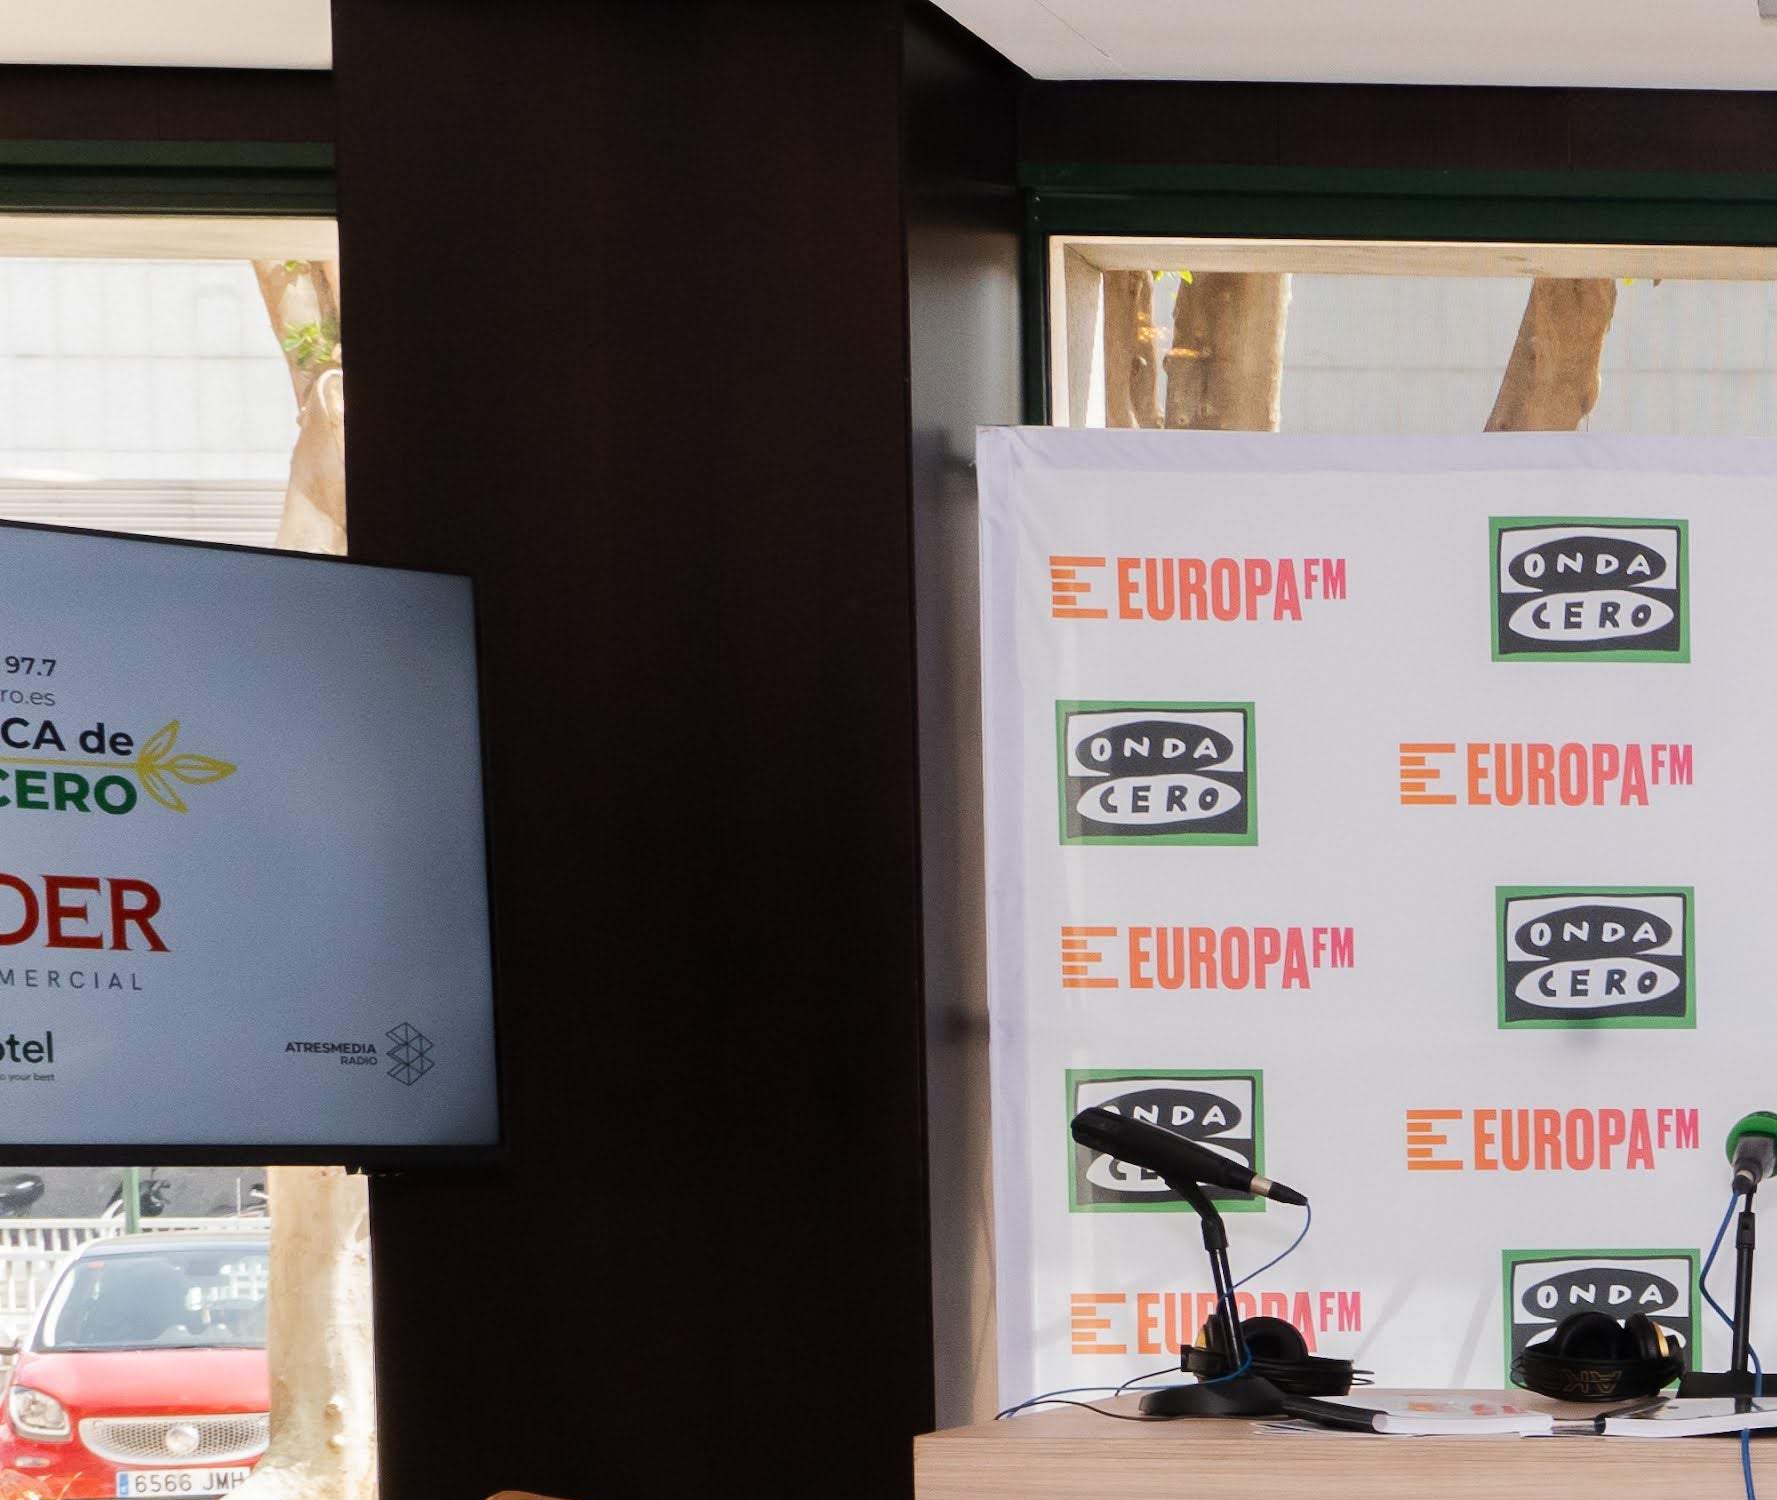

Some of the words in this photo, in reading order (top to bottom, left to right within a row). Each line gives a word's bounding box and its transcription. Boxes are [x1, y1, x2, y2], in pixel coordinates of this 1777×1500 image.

[1524, 553, 1650, 578] ONDA
[1532, 601, 1651, 629] CERO
[5, 656, 57, 677] 97.7
[79, 722, 134, 756] de
[1091, 737, 1217, 761] ONDA
[1100, 785, 1218, 813] CERO
[1531, 921, 1657, 946] ONDA
[1539, 969, 1657, 997] CERO
[0, 1031, 54, 1063] tel
[285, 1042, 377, 1055] ATRESMEDIA
[340, 1056, 378, 1066] RADIO
[1537, 1284, 1663, 1309] ONDA
[135, 1474, 193, 1493] 6566
